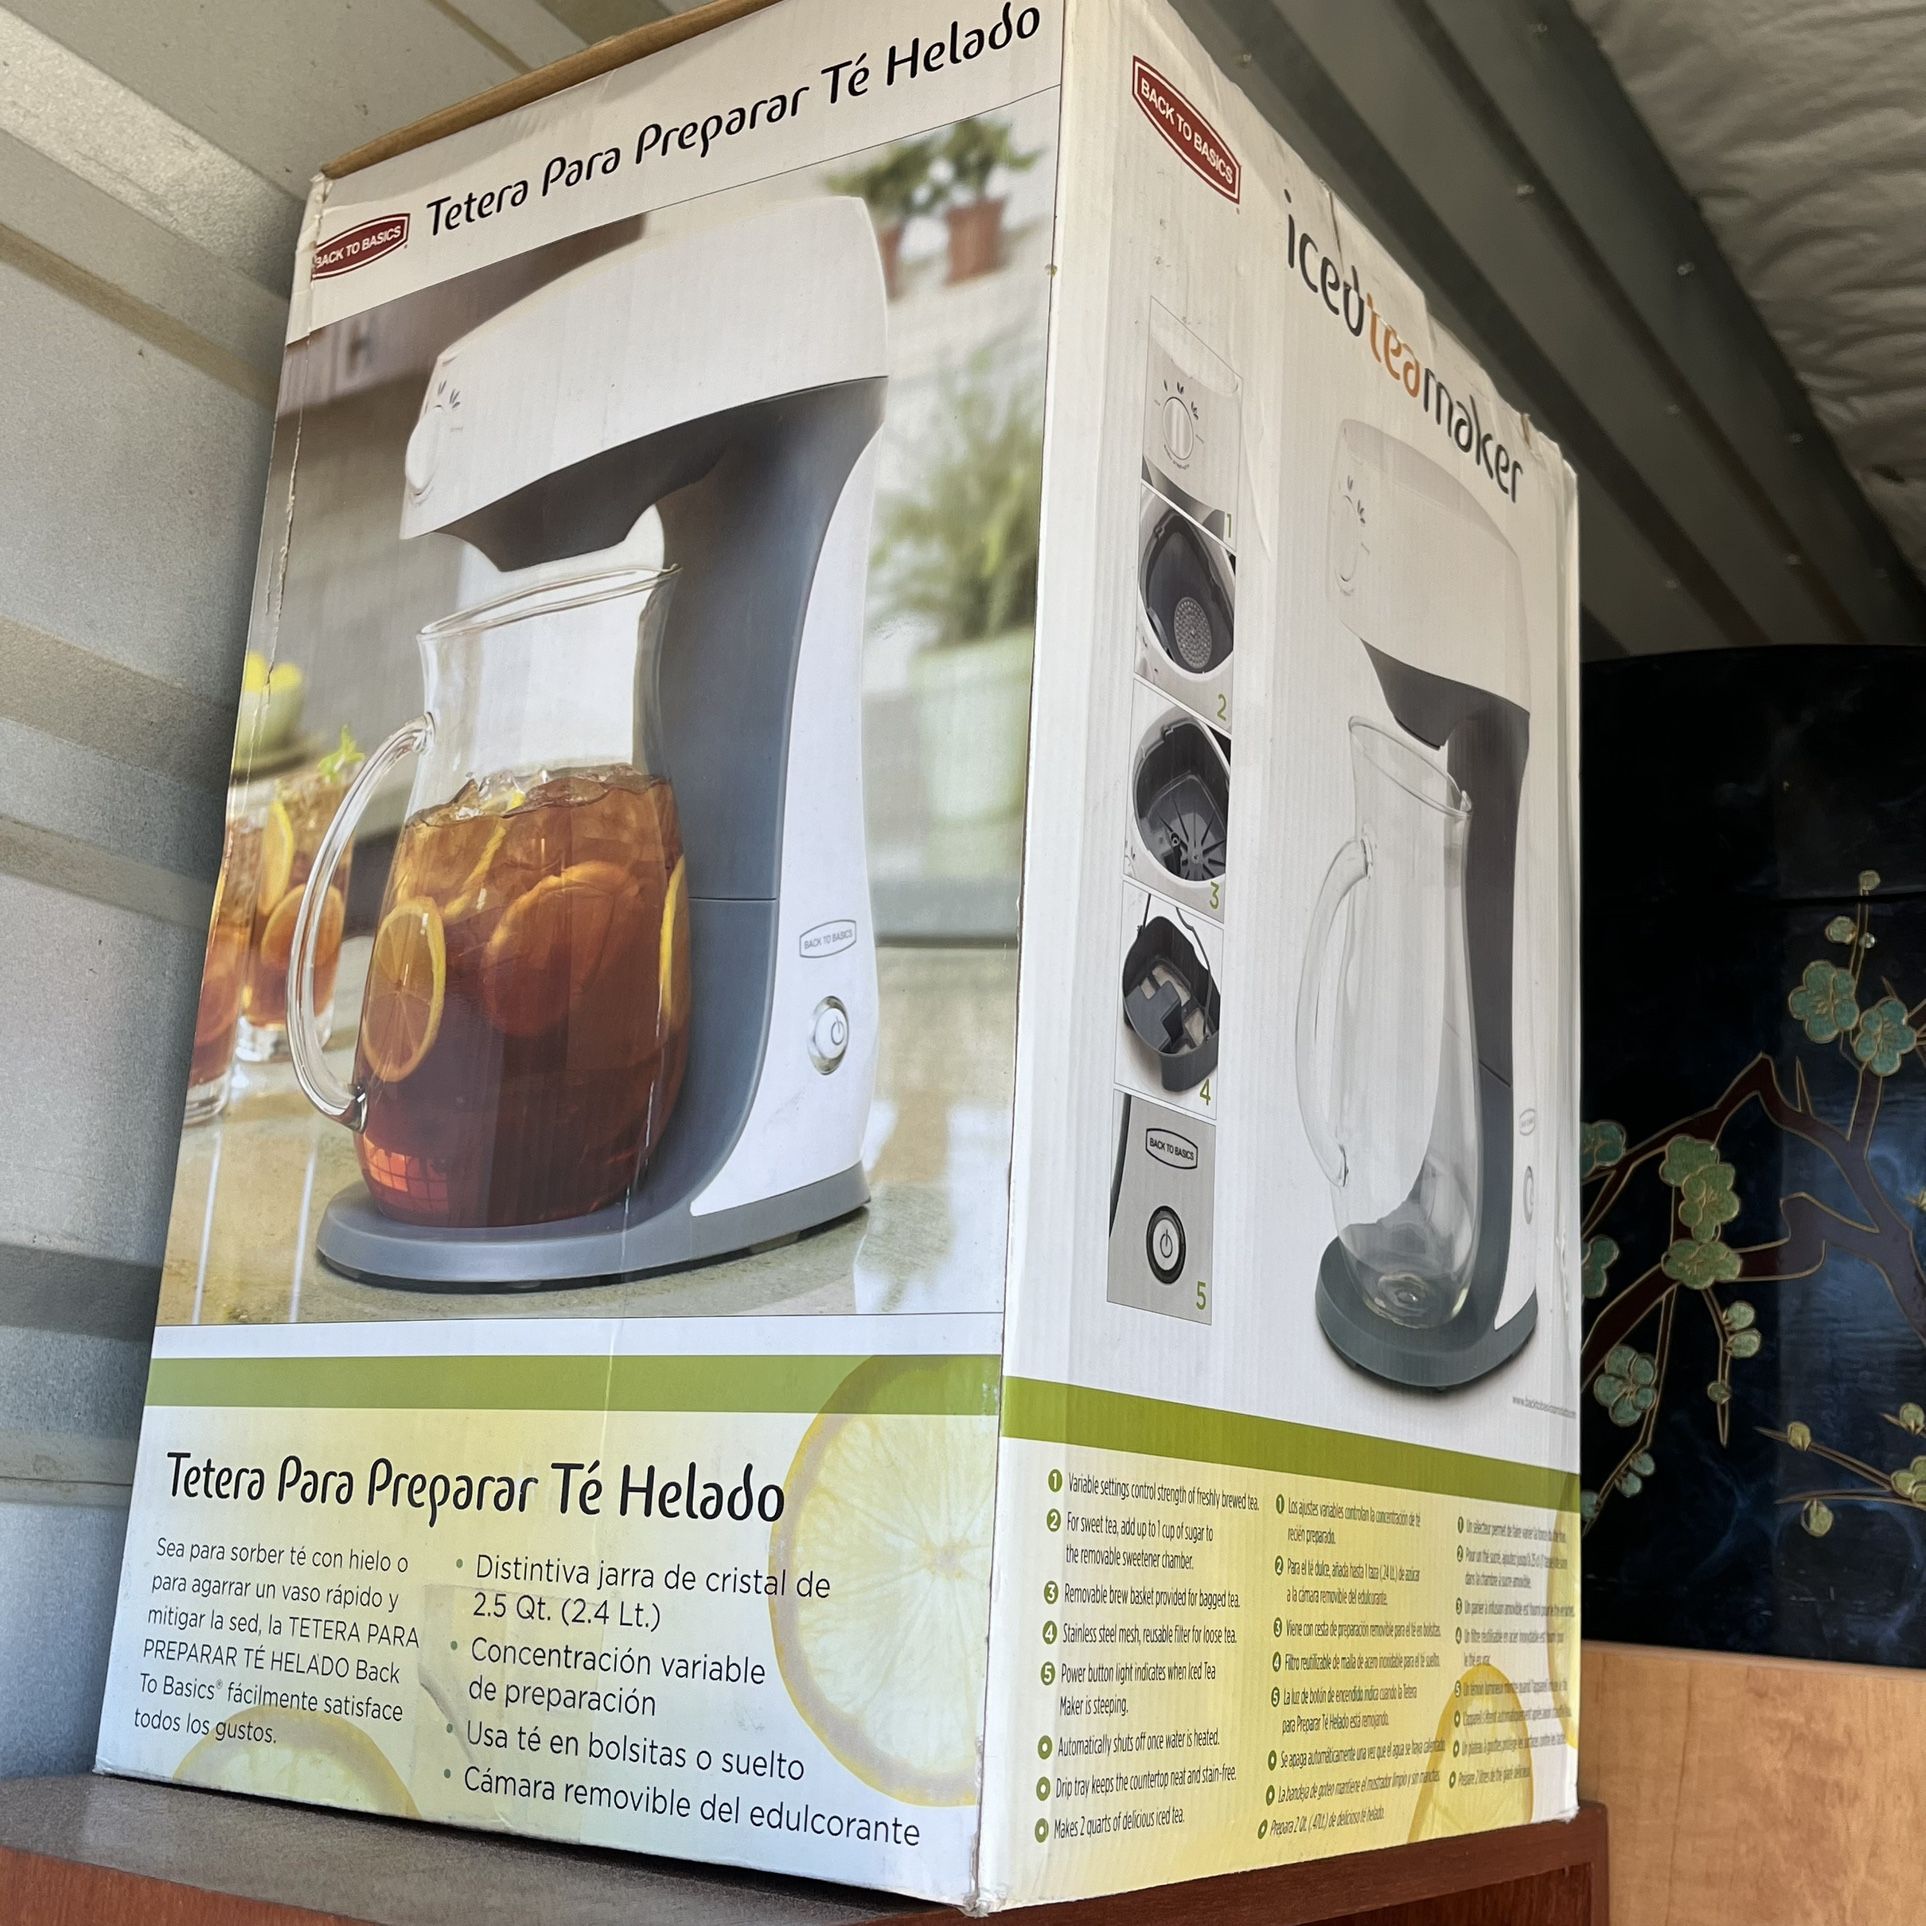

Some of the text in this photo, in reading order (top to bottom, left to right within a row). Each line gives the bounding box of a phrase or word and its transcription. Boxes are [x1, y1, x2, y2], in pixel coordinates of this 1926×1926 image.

[426, 1, 1041, 236] Tetera Para Preparar Té Helado
[1141, 77, 1233, 184] BACK TO BASICS
[313, 226, 401, 268] BACK TO BASICS
[1227, 513, 1232, 538] 1
[1217, 694, 1227, 721] 2
[1210, 881, 1219, 910] 3
[804, 929, 853, 950] BACK TO BASICS
[1200, 1079, 1211, 1106] 4
[1150, 1138, 1194, 1161] BACK TO BASICS
[1196, 1281, 1207, 1310] 5
[167, 1452, 785, 1528] Tetera Para Preparar Té Helado
[1068, 1472, 1099, 1494] Variable
[1100, 1478, 1129, 1500] settings
[1131, 1482, 1156, 1500] control
[1158, 1484, 1186, 1506] strength
[1188, 1486, 1195, 1504] of
[1197, 1487, 1220, 1509] freshly
[1222, 1490, 1246, 1509] brewed
[1248, 1493, 1259, 1511] tea.
[1067, 1512, 1079, 1531] For
[1080, 1516, 1103, 1533] sweet
[1105, 1516, 1119, 1537] tea,
[1121, 1517, 1135, 1536] add
[1137, 1521, 1146, 1539] up
[1149, 1521, 1155, 1537] to
[1158, 1520, 1160, 1537] 1
[1162, 1523, 1174, 1542] cup
[1176, 1522, 1184, 1539] of
[1185, 1526, 1204, 1543] sugar
[1206, 1525, 1213, 1541] to
[157, 1537, 408, 1572] Sea para sorber té con hielo o
[1066, 1544, 1194, 1569] the removable sweetener chamber.
[152, 1575, 399, 1612] para agarrar un vaso rápido y
[476, 1554, 830, 1598] Distintiva jarra de cristal de
[473, 1592, 660, 1632] 2.5 Qt. (2.4 Lt.)
[1065, 1583, 1107, 1603] Removable
[1110, 1585, 1128, 1604] brew
[1131, 1586, 1154, 1605] basket
[1155, 1587, 1186, 1608] provided
[1188, 1588, 1197, 1606] for
[1199, 1588, 1226, 1609] bagged
[1228, 1590, 1240, 1608] tea.
[148, 1605, 419, 1648] mitigar la sed, la TETERA PARA
[1063, 1623, 1096, 1643] Stainless
[1099, 1624, 1117, 1643] steel
[1119, 1624, 1141, 1645] mesh,
[1143, 1624, 1173, 1643] reusable
[1175, 1624, 1191, 1643] filter
[1192, 1625, 1201, 1643] for
[1203, 1625, 1222, 1643] loose
[1224, 1626, 1237, 1643] tea.
[144, 1638, 400, 1684] PREPARAR TÉ HELADO Back
[472, 1636, 765, 1684] Concentración variable
[1061, 1663, 1086, 1683] Power
[1088, 1662, 1113, 1682] button
[1116, 1662, 1133, 1685] light
[1135, 1662, 1166, 1681] indicates
[1168, 1662, 1186, 1680] when
[1188, 1662, 1202, 1679] Iced
[1204, 1661, 1216, 1679] Tea
[140, 1673, 158, 1693] To
[227, 1682, 318, 1711] fácilmente
[324, 1695, 403, 1721] satisface
[469, 1675, 656, 1716] de preparación
[1060, 1694, 1128, 1716] Maker is steeping.
[134, 1708, 276, 1744] todos los gustos.
[1058, 1728, 1219, 1756] Automatically shuts off once water is heated.
[467, 1720, 805, 1780] Usa té en bolsitas o suelto
[1056, 1763, 1236, 1799] Drip tray keeps the countertop neat and stain-free.
[464, 1766, 920, 1846] Cámara removible del edulcorante
[1054, 1806, 1184, 1839] Makes 2 quarts of delicious iced tea.
